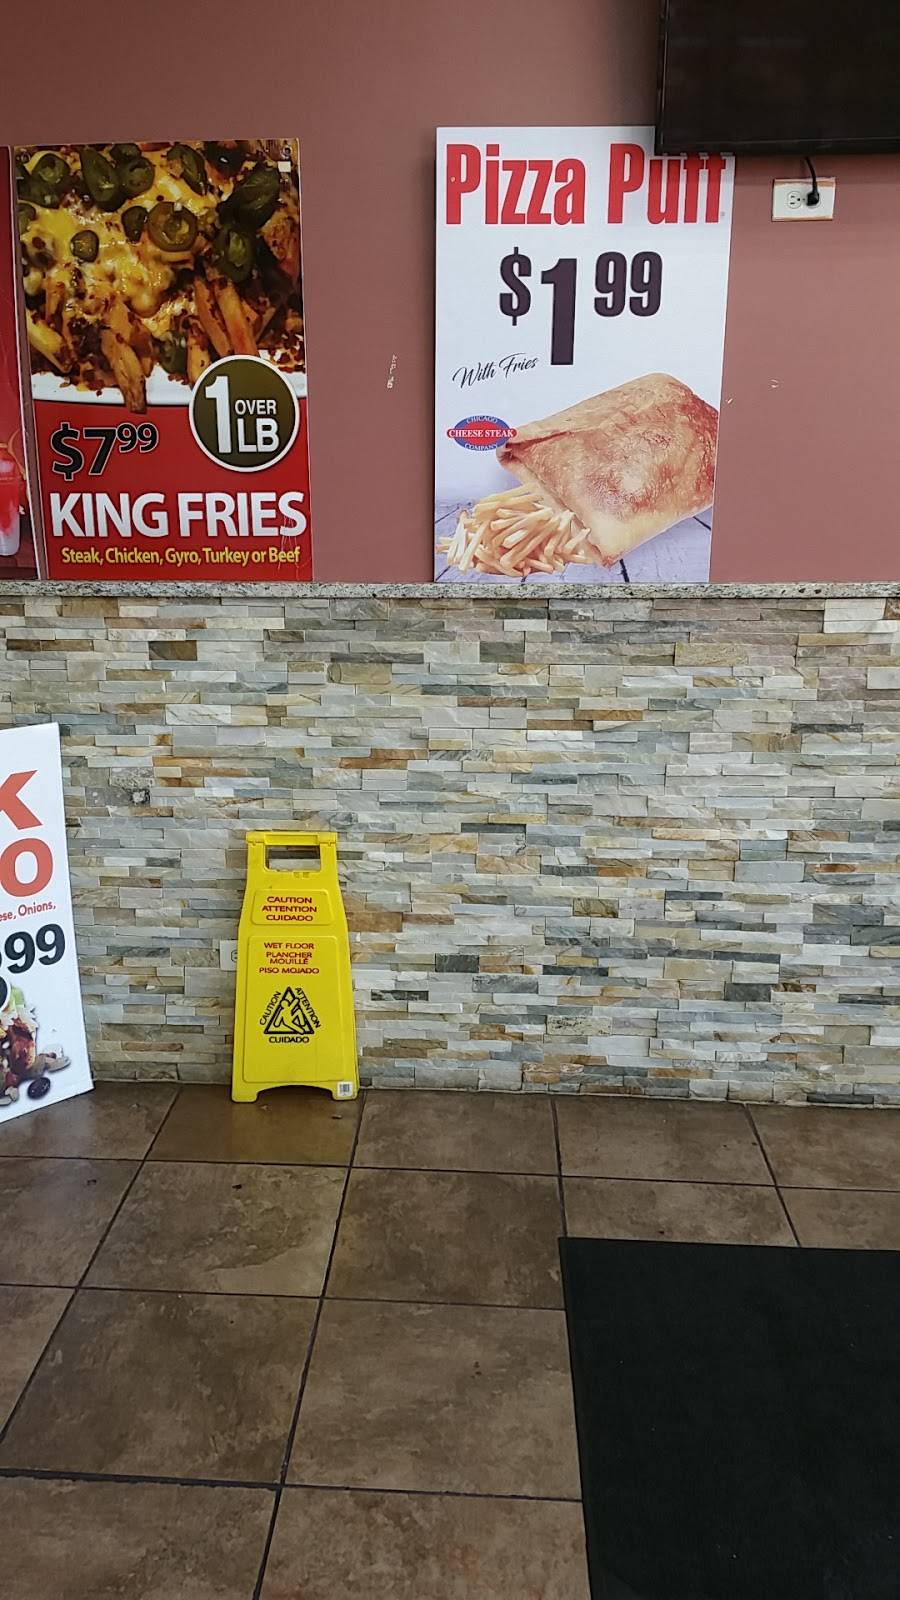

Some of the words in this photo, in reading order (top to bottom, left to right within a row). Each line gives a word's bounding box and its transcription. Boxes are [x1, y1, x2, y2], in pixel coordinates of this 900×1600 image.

[445, 143, 585, 224] Pizza
[607, 143, 726, 224] Puff
[452, 362, 496, 388] With
[499, 353, 539, 378] Fries
[205, 375, 231, 453] 1
[235, 399, 276, 416] OVER
[238, 418, 280, 453] LB
[448, 429, 484, 437] CHEESE
[485, 429, 514, 437] STEAK
[50, 492, 168, 538] KING
[178, 491, 307, 537] FRIES
[62, 547, 104, 565] Steak,
[105, 547, 164, 565] Chicken,
[165, 547, 202, 567] Gyro,
[203, 547, 248, 566] Turkey
[251, 551, 267, 562] or
[269, 547, 300, 563] Beef
[18, 902, 56, 916] Onions,
[262, 905, 317, 913] ATTENTION
[267, 896, 312, 904] CAUTION
[266, 914, 313, 922] CUIDADO
[0, 924, 66, 974] 99
[259, 991, 281, 1025] CAUTION
[295, 987, 321, 1028] ATTENTION
